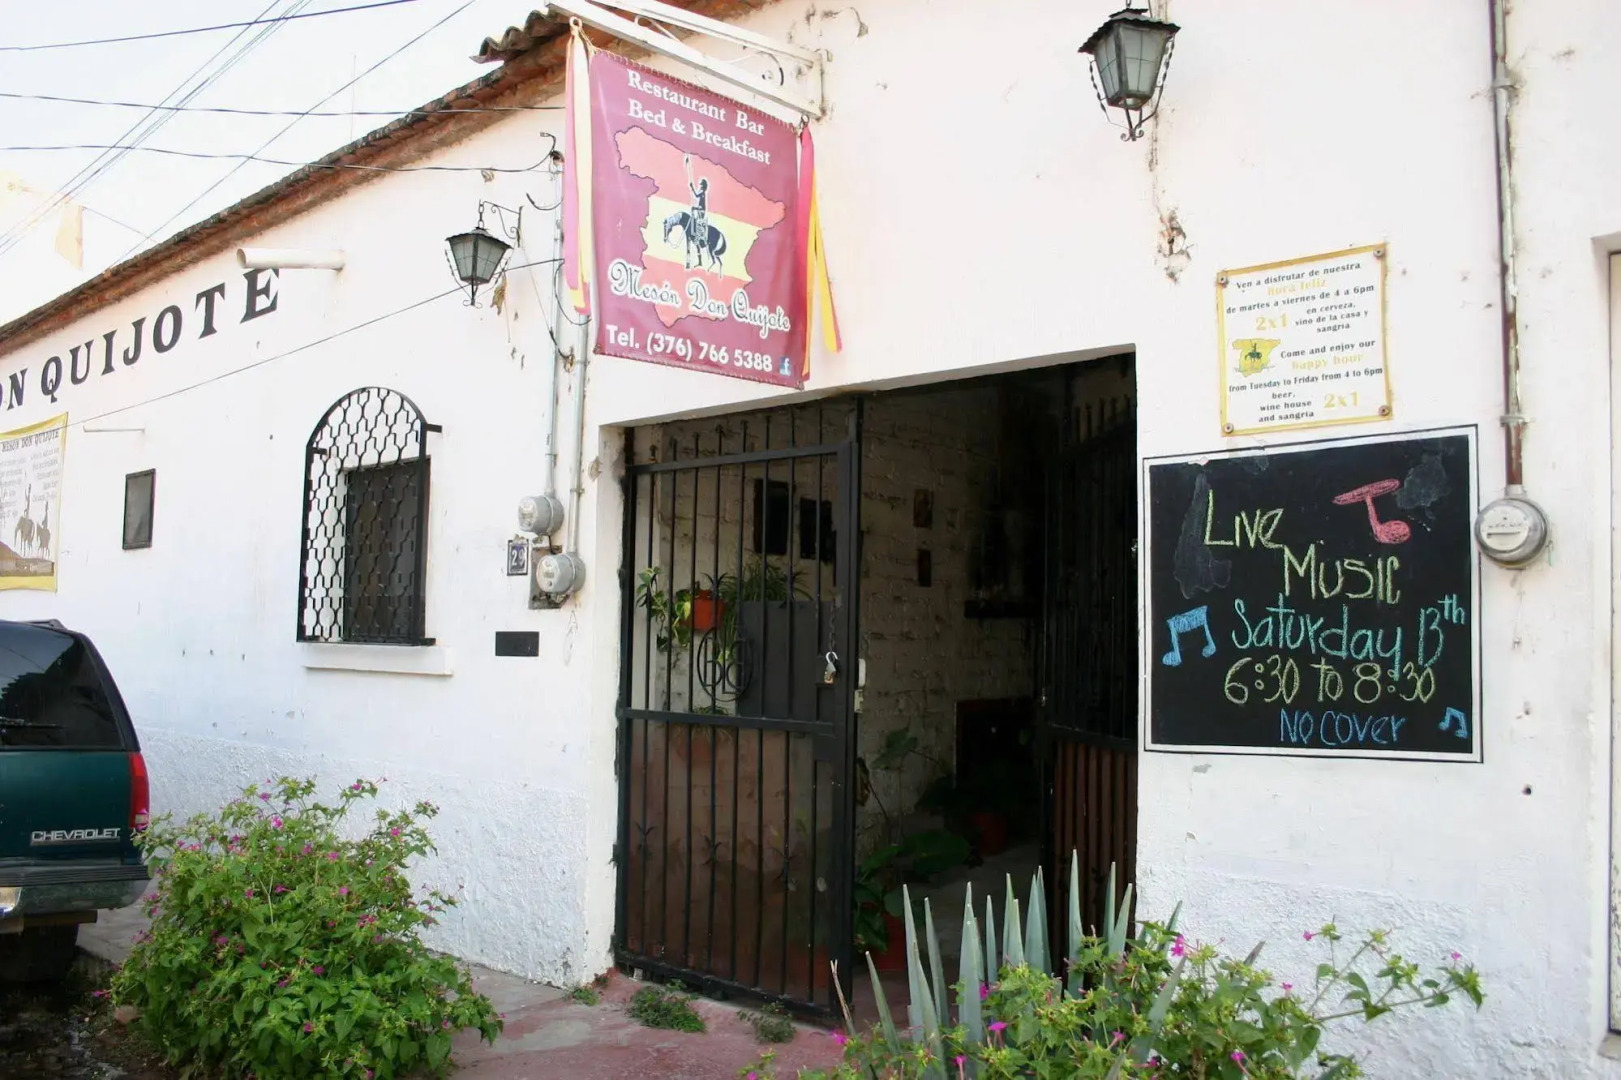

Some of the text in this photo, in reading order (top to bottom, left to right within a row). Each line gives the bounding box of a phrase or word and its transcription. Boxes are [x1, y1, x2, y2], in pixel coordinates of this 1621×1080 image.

[627, 68, 765, 136] Restaurant Bar
[628, 98, 771, 165] Bed & Breakfast
[1236, 279, 1253, 290] Ven
[1264, 271, 1305, 285] disfrutar
[1309, 268, 1320, 277] de
[1323, 262, 1361, 275] nuestra
[608, 259, 791, 338] Mesón Don Quijote
[1226, 306, 1236, 314] de
[1239, 302, 1270, 312] martes
[1282, 294, 1316, 306] viernes
[1320, 291, 1330, 300] de
[1334, 289, 1340, 298] 4
[1353, 284, 1374, 298] 6pm
[1256, 313, 1288, 331] 2x1
[1295, 309, 1369, 327] vino de la casa y
[1306, 307, 1317, 315] en
[0, 267, 280, 411] N QUIJOTE
[606, 324, 773, 372] Tel. (376) 766 5388
[1280, 339, 1376, 359] Come and enjoy our
[1291, 357, 1328, 371] happy
[1333, 353, 1363, 366] hour
[1229, 366, 1384, 393] from Tuesday to Friday from 4 to 6pm
[1260, 400, 1312, 412] wine house
[1324, 391, 1360, 409] 2x1
[1258, 414, 1275, 423] and
[511, 549, 525, 567] 29
[1231, 592, 1403, 682] Saturday
[1224, 654, 1301, 704] 6:30
[1353, 661, 1436, 704] 8:30
[31, 828, 121, 842] CHEVROLET
